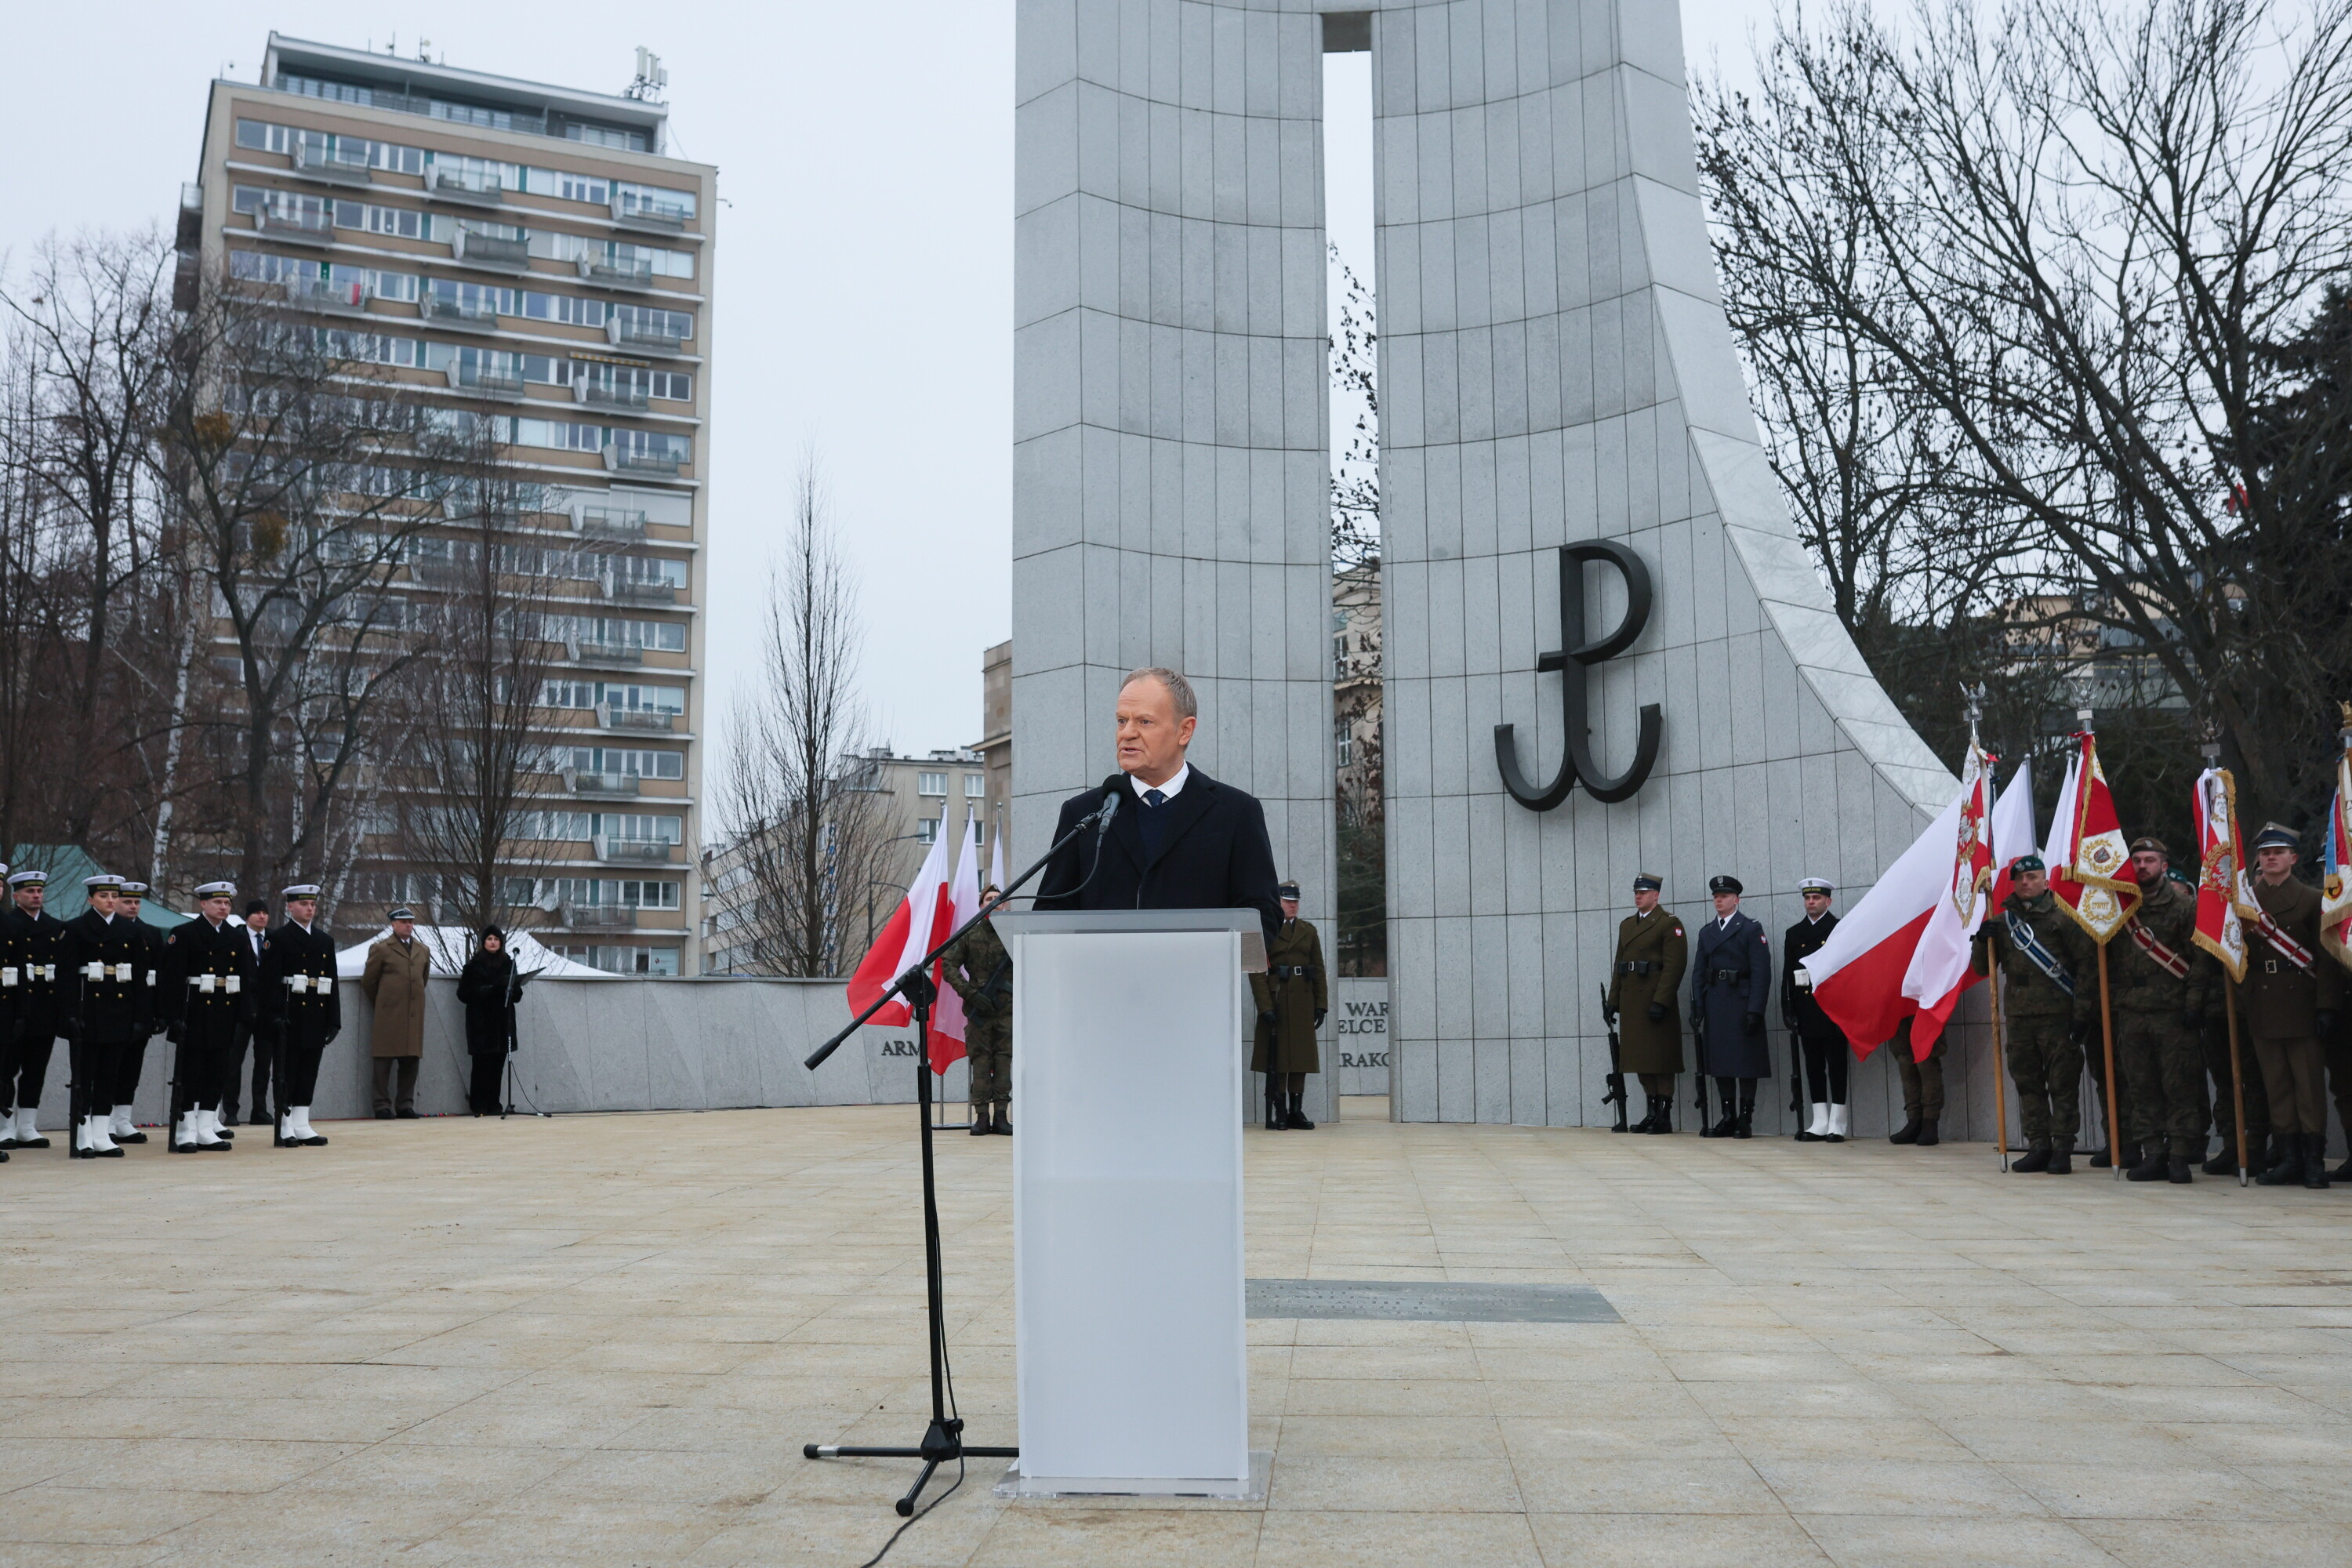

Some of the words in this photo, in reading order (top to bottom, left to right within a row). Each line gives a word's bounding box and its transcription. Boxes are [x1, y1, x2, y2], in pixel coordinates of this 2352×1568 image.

[1345, 1002, 1388, 1017] WAR
[1338, 1019, 1386, 1033] ELCE
[1339, 1052, 1388, 1067] RAK
